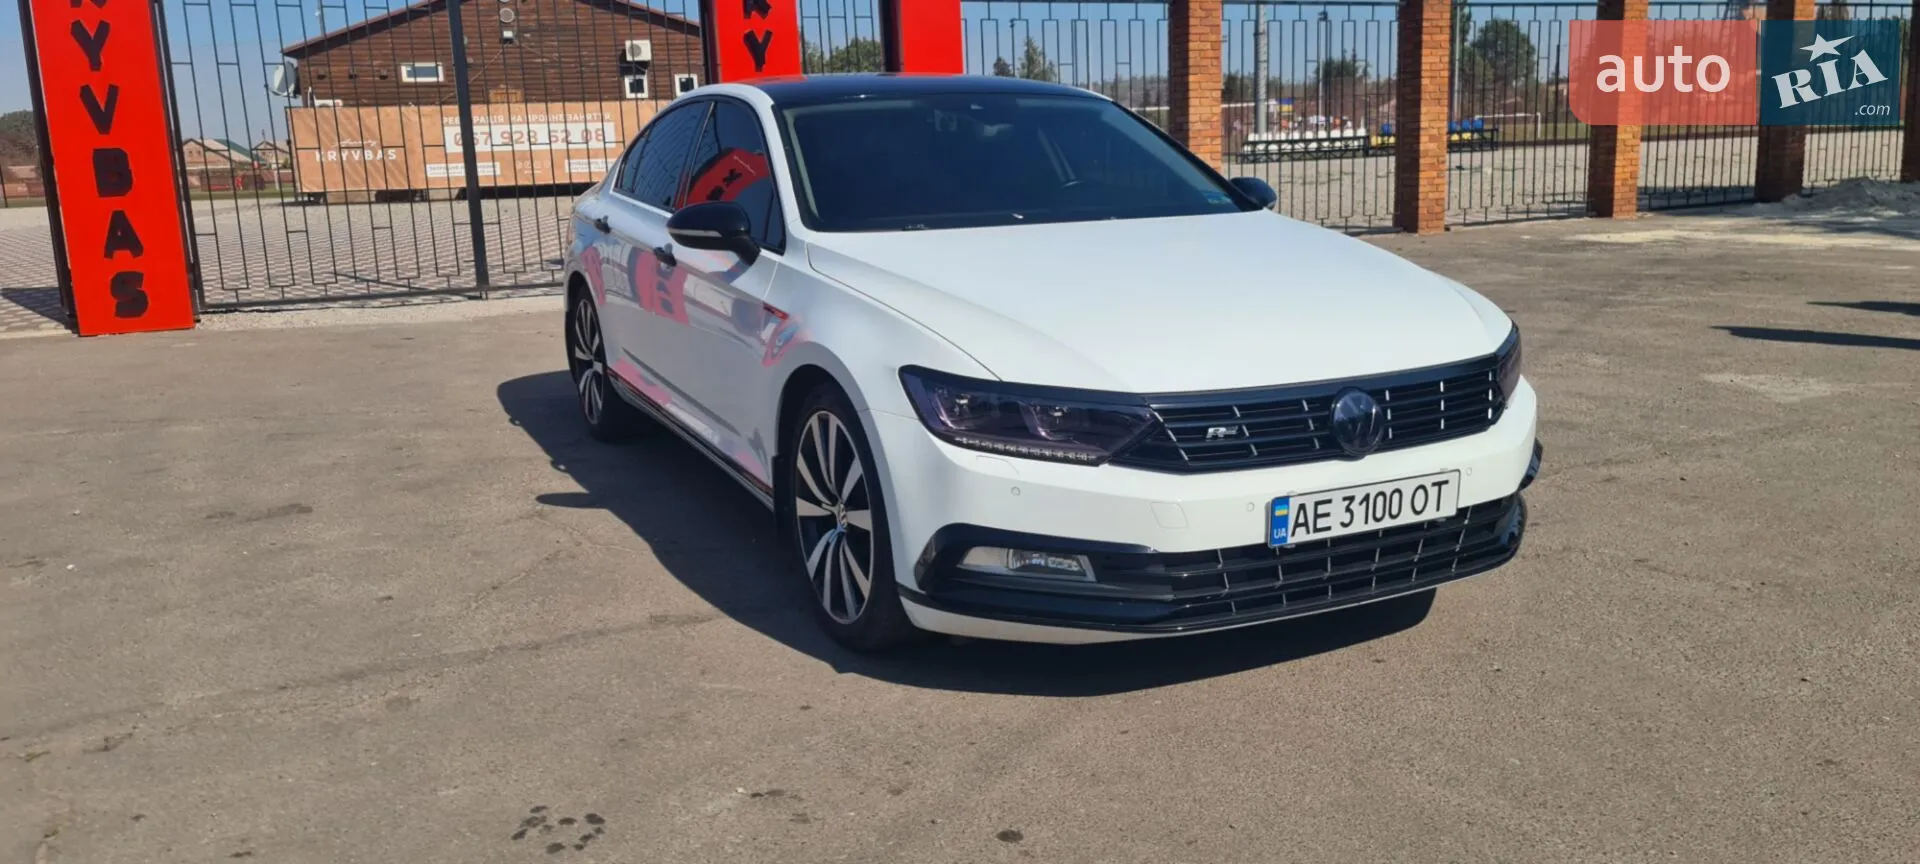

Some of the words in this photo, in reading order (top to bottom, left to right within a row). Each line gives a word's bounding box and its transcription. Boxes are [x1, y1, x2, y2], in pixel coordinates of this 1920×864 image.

[70, 0, 149, 318] YVBAS
[315, 149, 396, 162] KRYVBAS
[1291, 499, 1333, 537] AE
[1340, 488, 1403, 528] 3100
[1411, 480, 1449, 515] OT
[1274, 528, 1287, 539] UA
